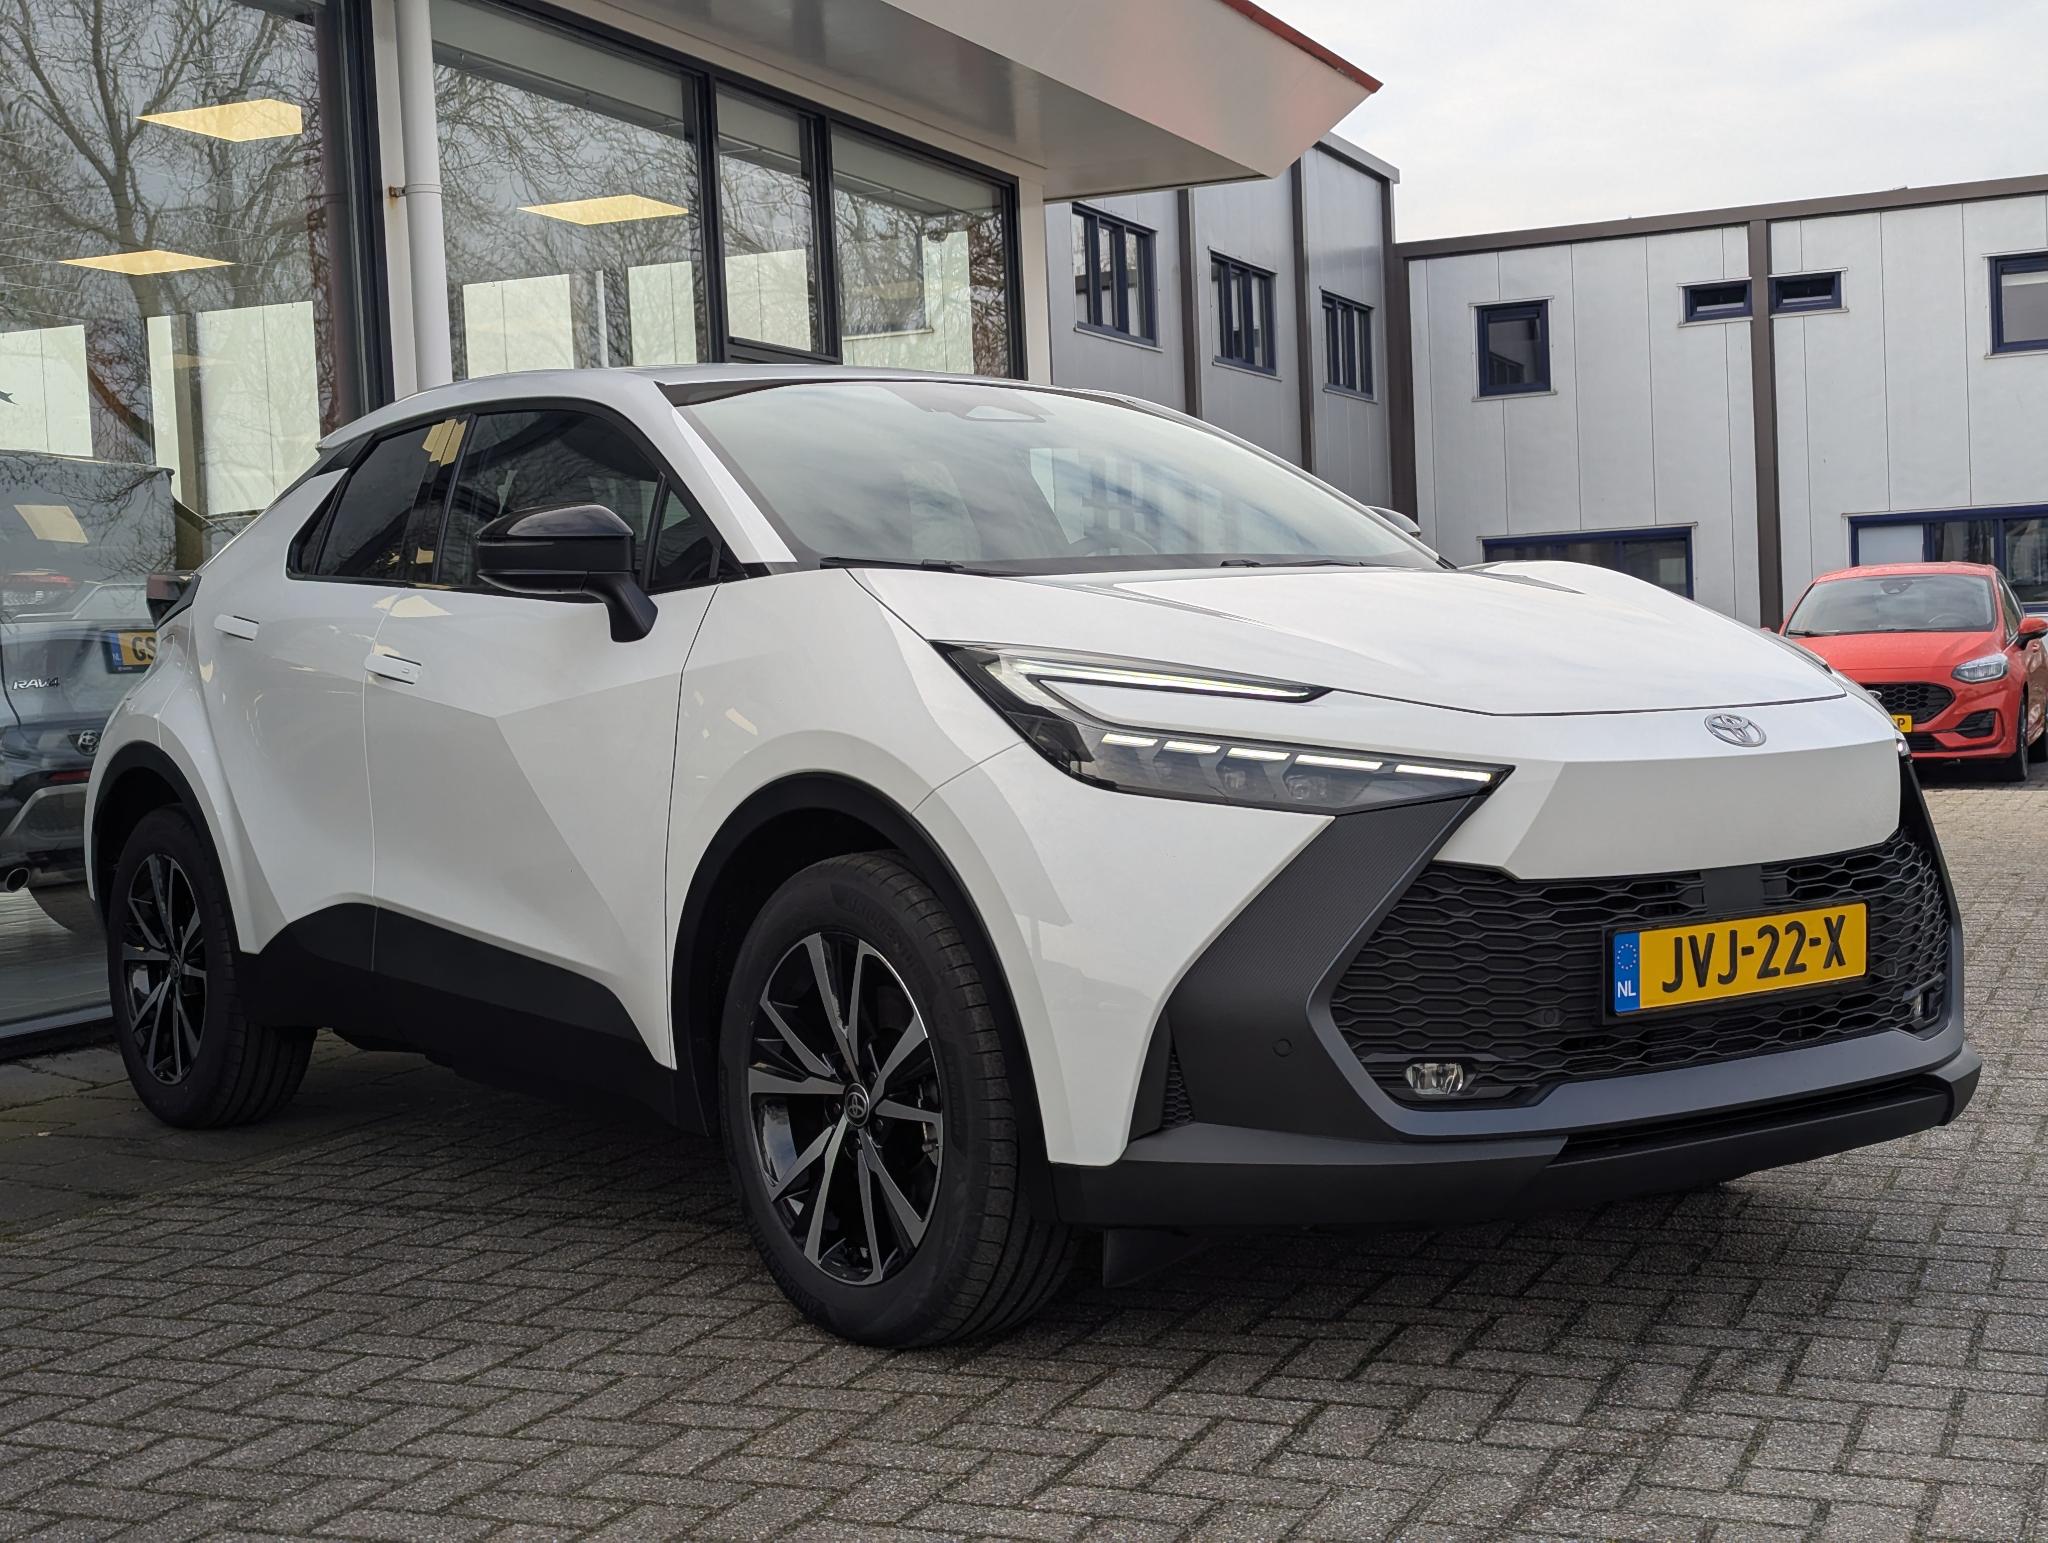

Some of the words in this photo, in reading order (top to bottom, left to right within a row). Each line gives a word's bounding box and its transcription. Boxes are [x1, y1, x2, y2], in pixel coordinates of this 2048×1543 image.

[12, 677, 60, 690] RAV4
[1662, 915, 1846, 993] JVJ-22-X
[1617, 980, 1636, 998] NL
